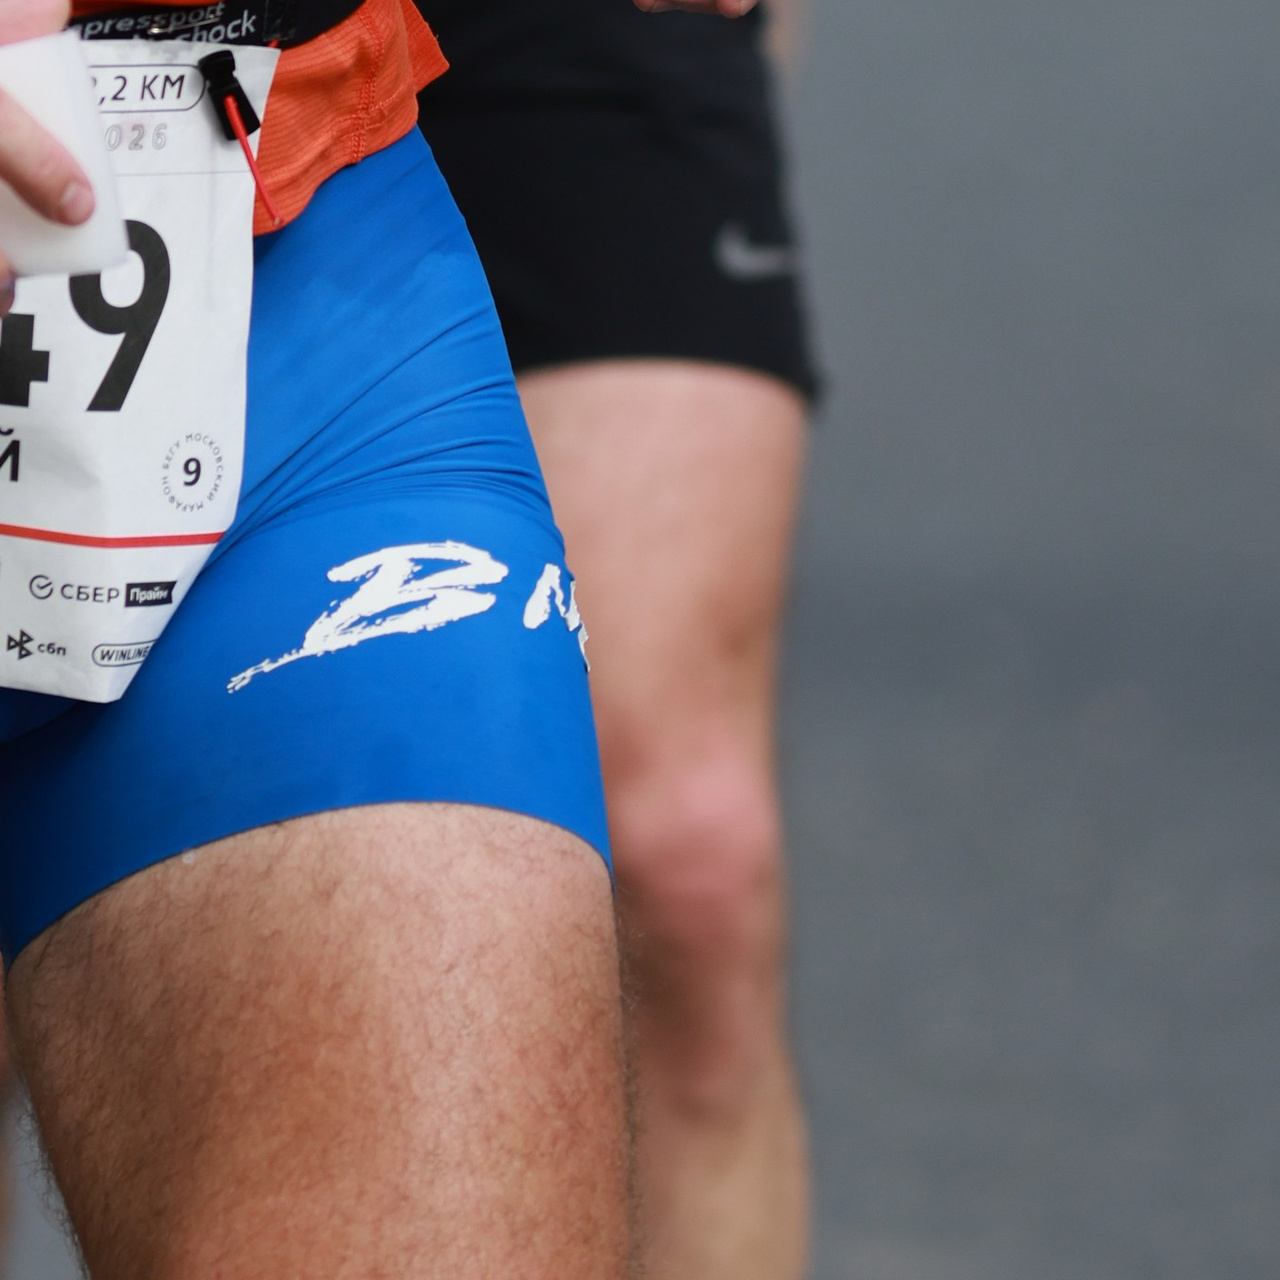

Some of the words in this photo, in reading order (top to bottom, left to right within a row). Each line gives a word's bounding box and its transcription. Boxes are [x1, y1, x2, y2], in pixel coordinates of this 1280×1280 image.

[78, 1, 225, 40] pressport
[91, 74, 127, 105] ,2
[104, 123, 168, 152] 026
[183, 457, 202, 487] 9
[60, 583, 120, 603] СБЕР
[129, 586, 169, 604] Прайм
[37, 642, 67, 657] сбп
